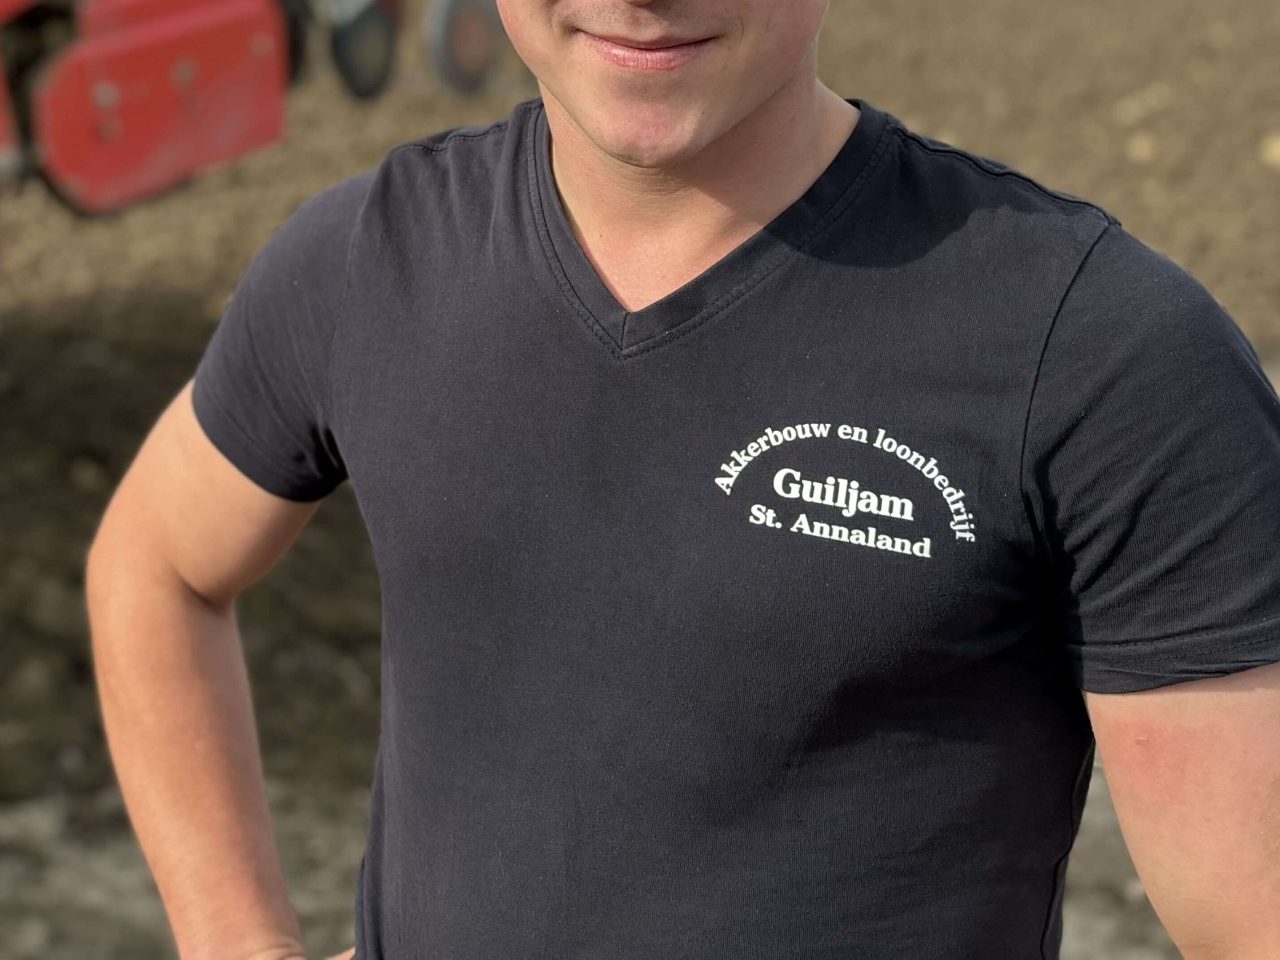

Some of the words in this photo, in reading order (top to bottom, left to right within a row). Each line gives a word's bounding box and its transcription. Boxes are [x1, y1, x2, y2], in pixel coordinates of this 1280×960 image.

[714, 422, 832, 496] Akkerbouw
[837, 424, 869, 444] en
[872, 428, 976, 543] loonbedrijf
[772, 467, 915, 522] Guiljam
[748, 503, 783, 529] St.
[789, 513, 932, 558] Annaland
